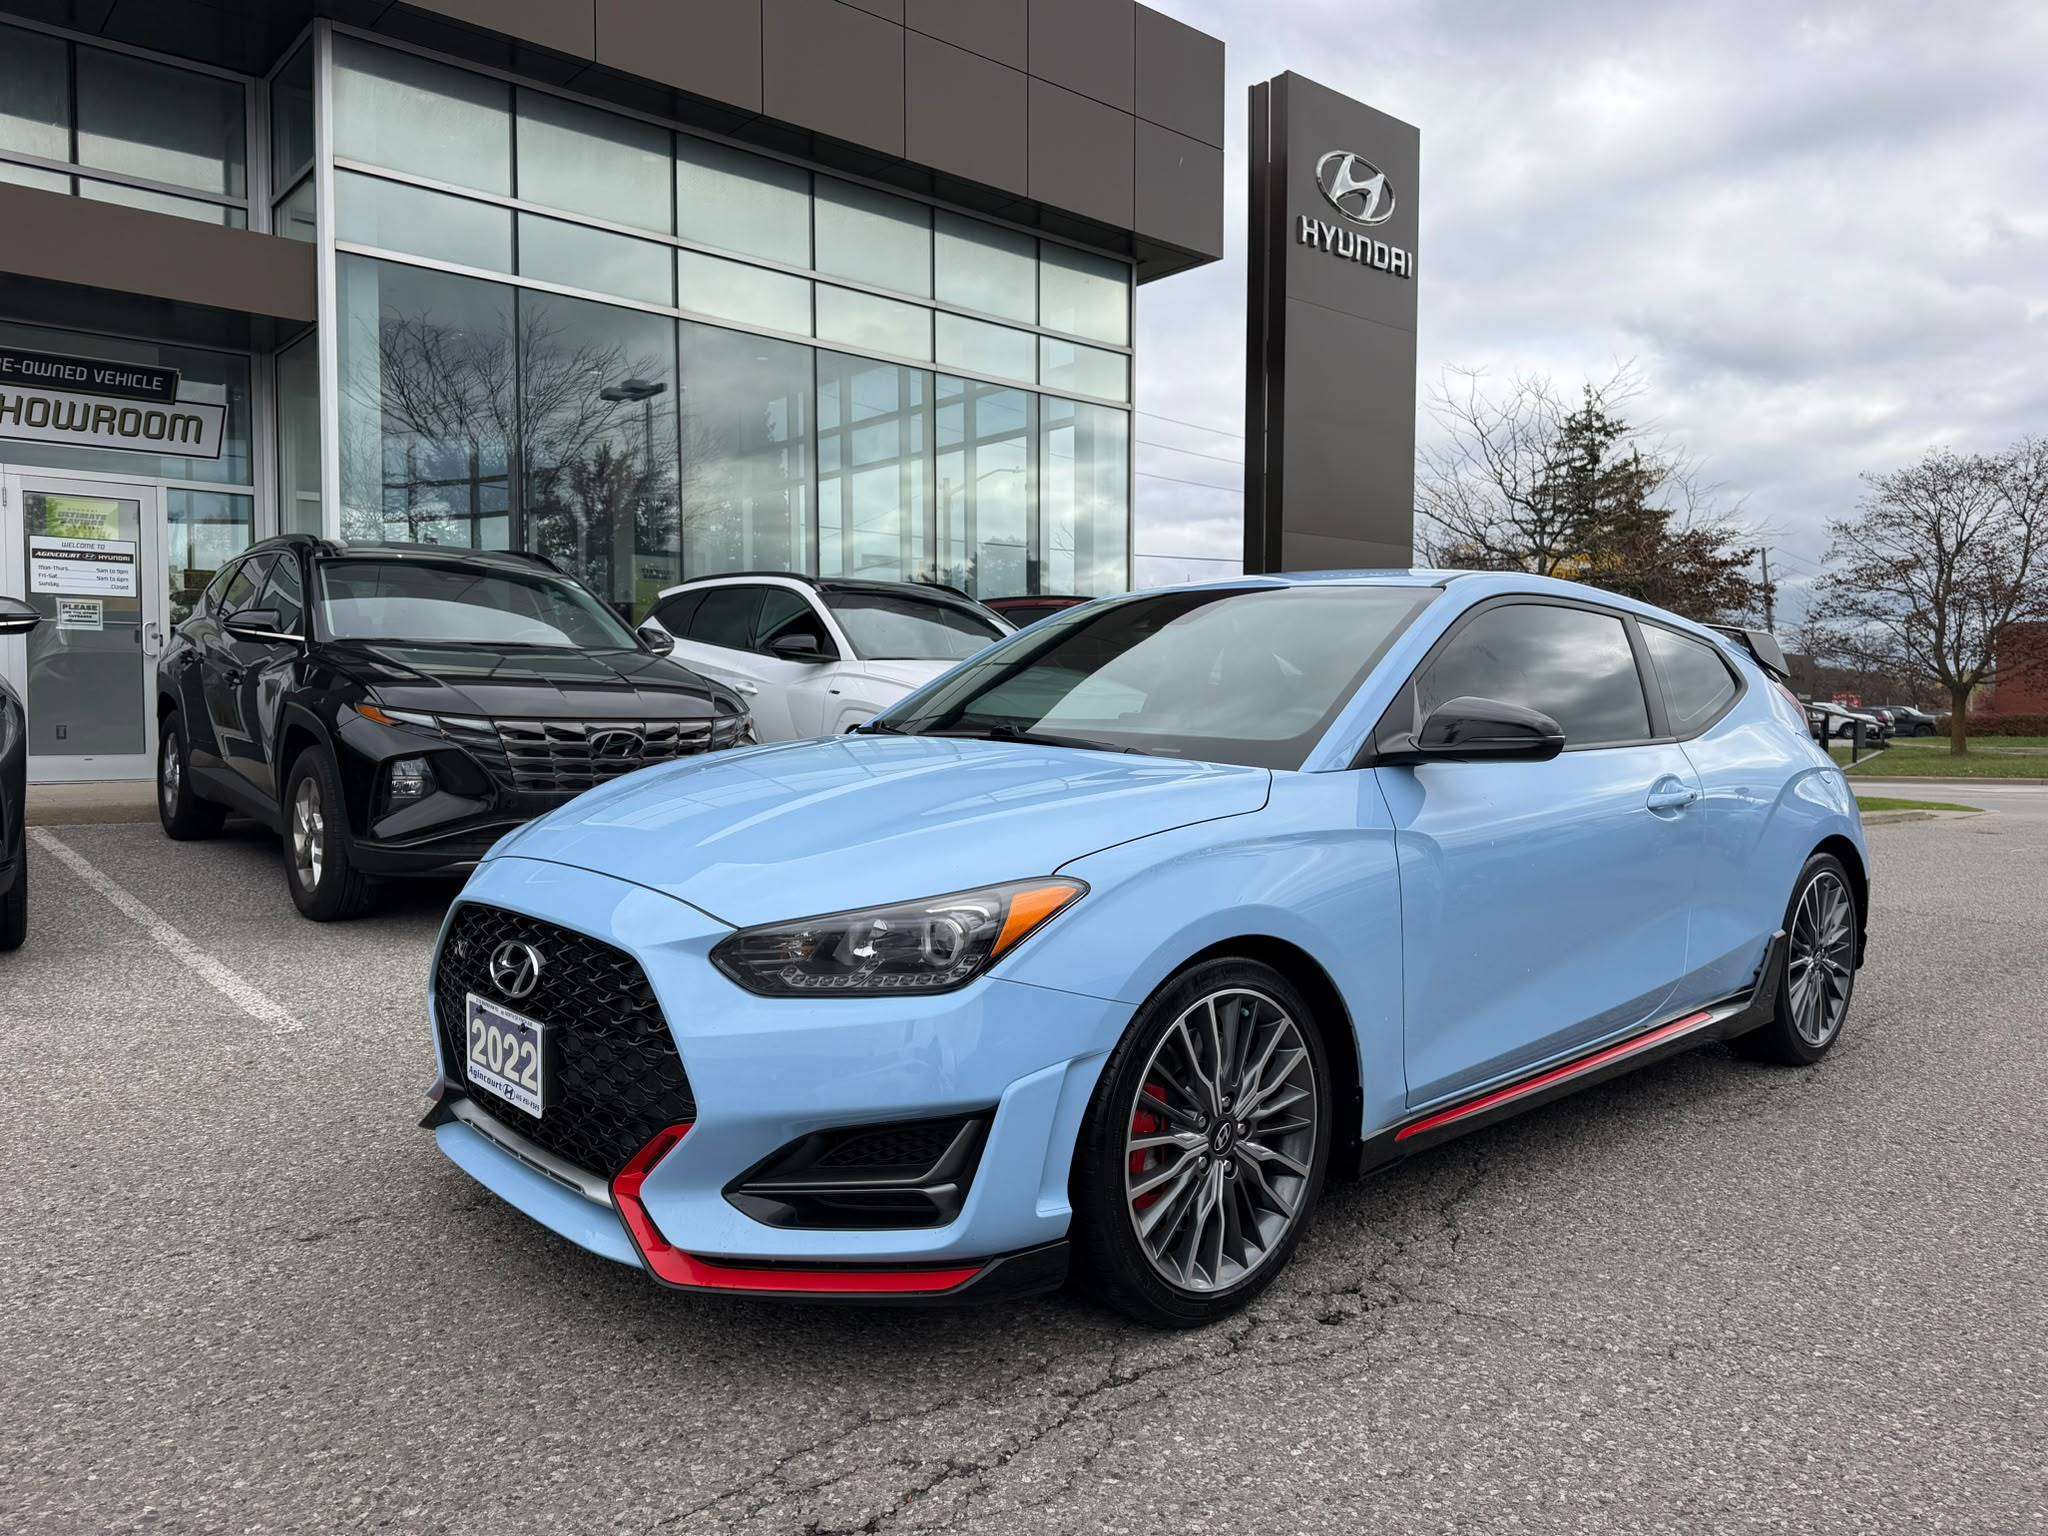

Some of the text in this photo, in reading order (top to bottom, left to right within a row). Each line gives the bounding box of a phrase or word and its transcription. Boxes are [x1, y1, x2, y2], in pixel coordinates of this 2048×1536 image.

[1297, 214, 1413, 279] HYUNDAI
[0, 357, 164, 391] E-OWNED VEHICLE
[35, 550, 131, 562] AGINCOURT HYUNDAI
[61, 541, 95, 550] WELCOME
[471, 1018, 538, 1092] 2022
[468, 1065, 503, 1091] Agincourt
